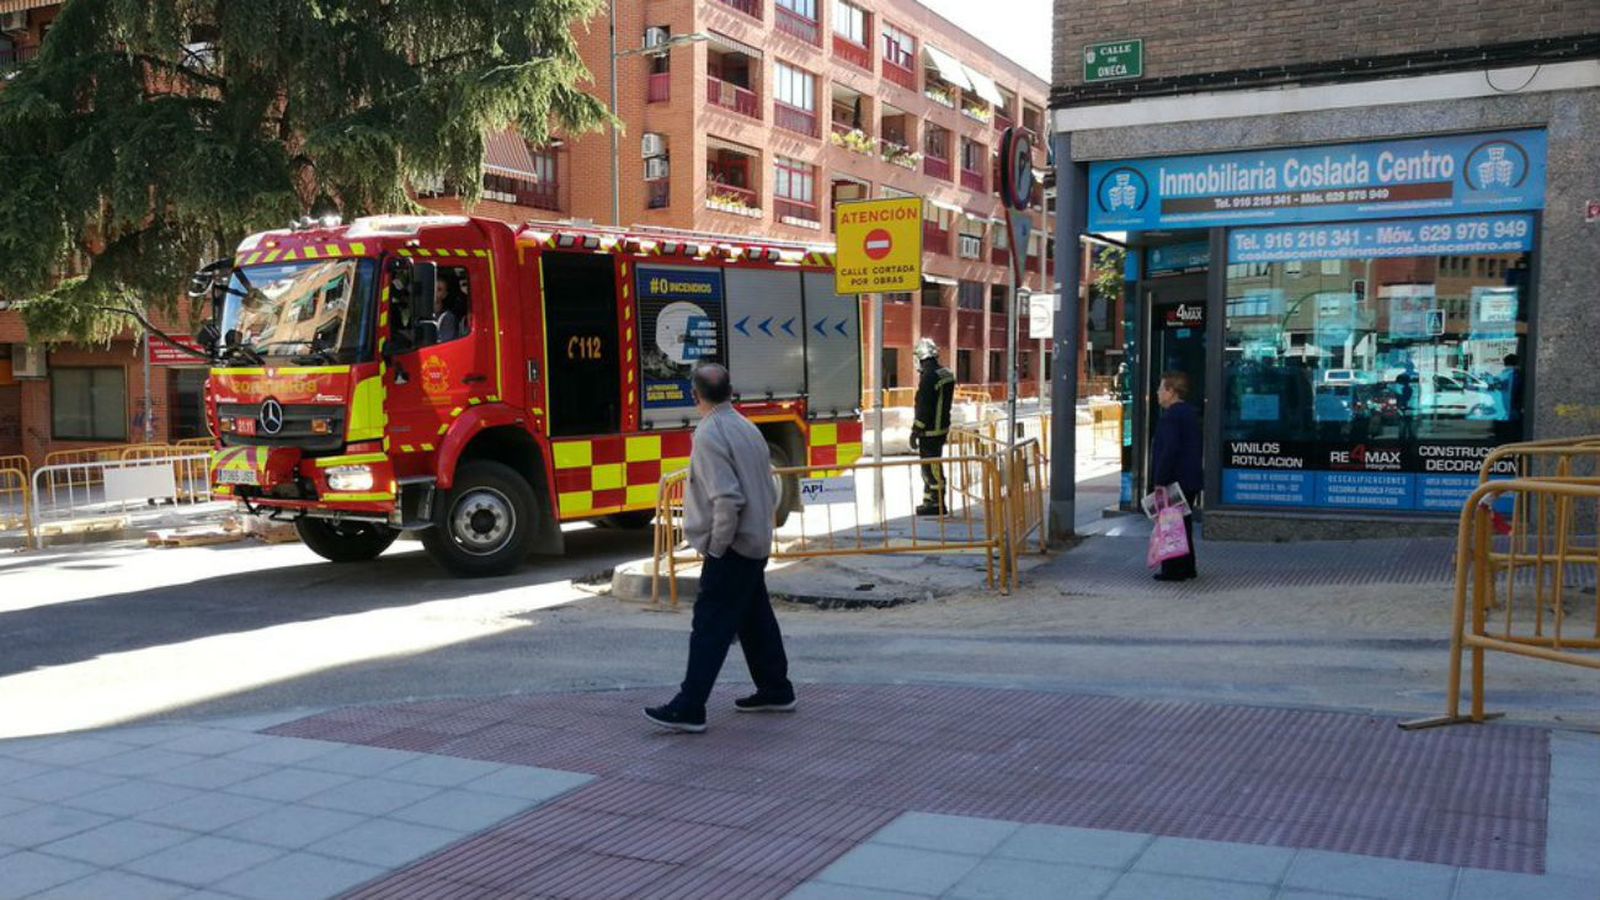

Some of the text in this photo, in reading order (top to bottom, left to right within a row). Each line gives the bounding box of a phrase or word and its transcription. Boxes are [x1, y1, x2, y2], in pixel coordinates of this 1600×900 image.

[1100, 44, 1132, 56] CALLE
[1098, 64, 1127, 77] ONECA
[1159, 150, 1454, 196] Inmobiliaria Coslada Centro
[841, 206, 917, 224] ATENCIÓN
[1235, 234, 1261, 250] Tel.
[1265, 232, 1293, 249] 916
[1298, 231, 1327, 248] 216
[1331, 229, 1359, 246] 341
[1377, 227, 1414, 244] Móv.
[1420, 225, 1450, 241] 629
[1456, 223, 1487, 239] 976
[1494, 221, 1527, 237] 949
[841, 265, 915, 276] CALLE CORTADA
[873, 276, 904, 284] OBRAS
[669, 282, 712, 294] INCENDIOS
[580, 337, 601, 359] 112
[1231, 442, 1280, 453] VINILOS
[1419, 446, 1519, 459] CONSTRUC
[1426, 459, 1517, 472] DECORAION
[802, 484, 823, 493] API
